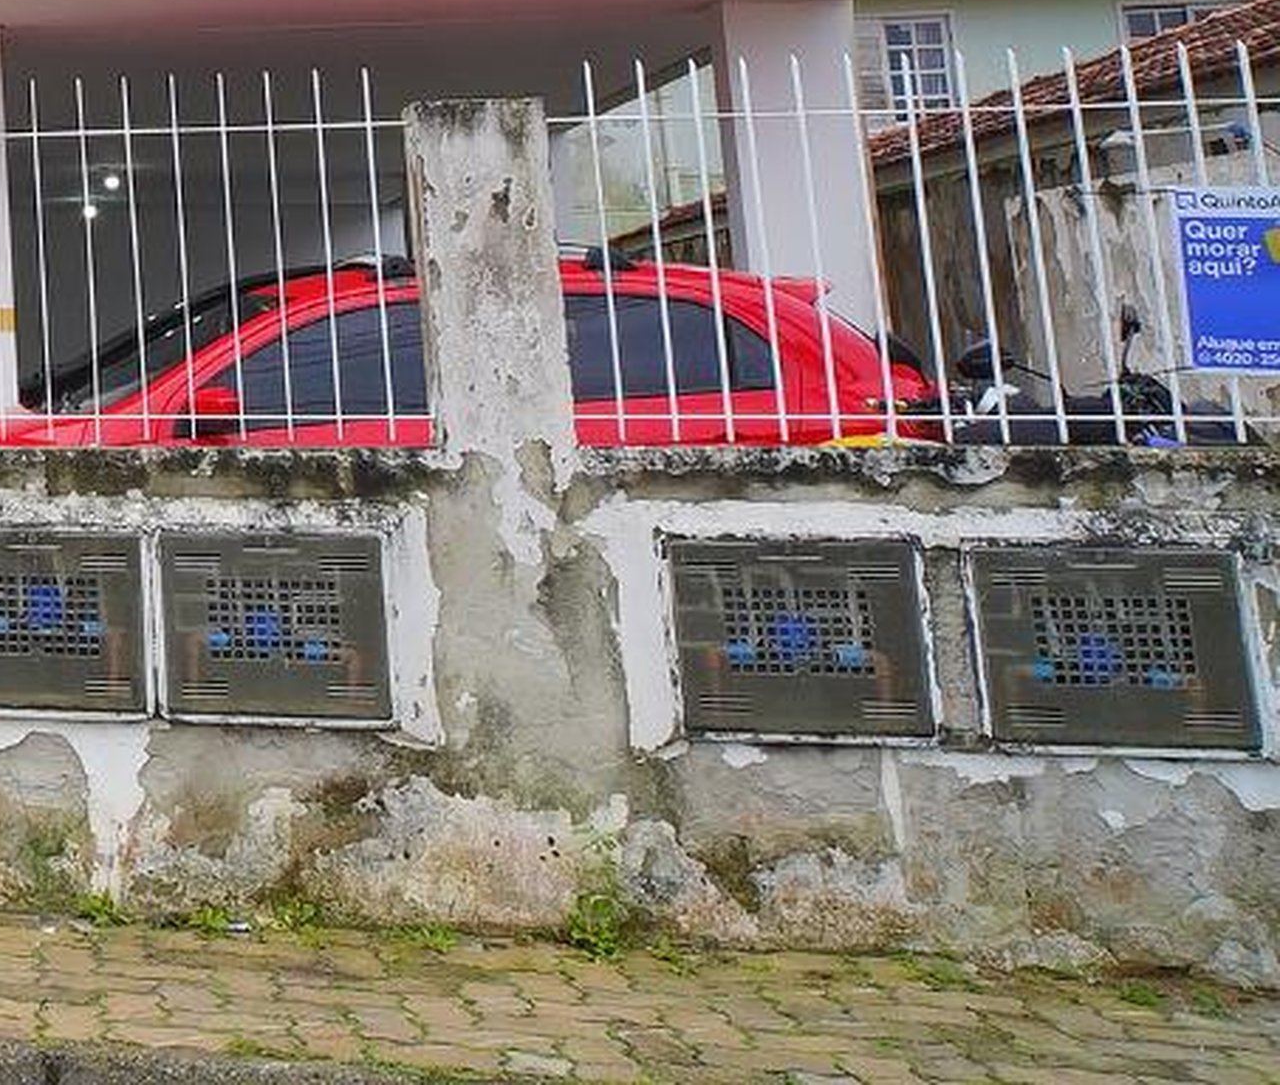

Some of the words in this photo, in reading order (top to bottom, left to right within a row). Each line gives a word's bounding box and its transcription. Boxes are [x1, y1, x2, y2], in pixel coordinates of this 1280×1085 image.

[1185, 220, 1250, 241] Quer
[1187, 242, 1262, 258] morar
[1188, 256, 1257, 278] aqui?
